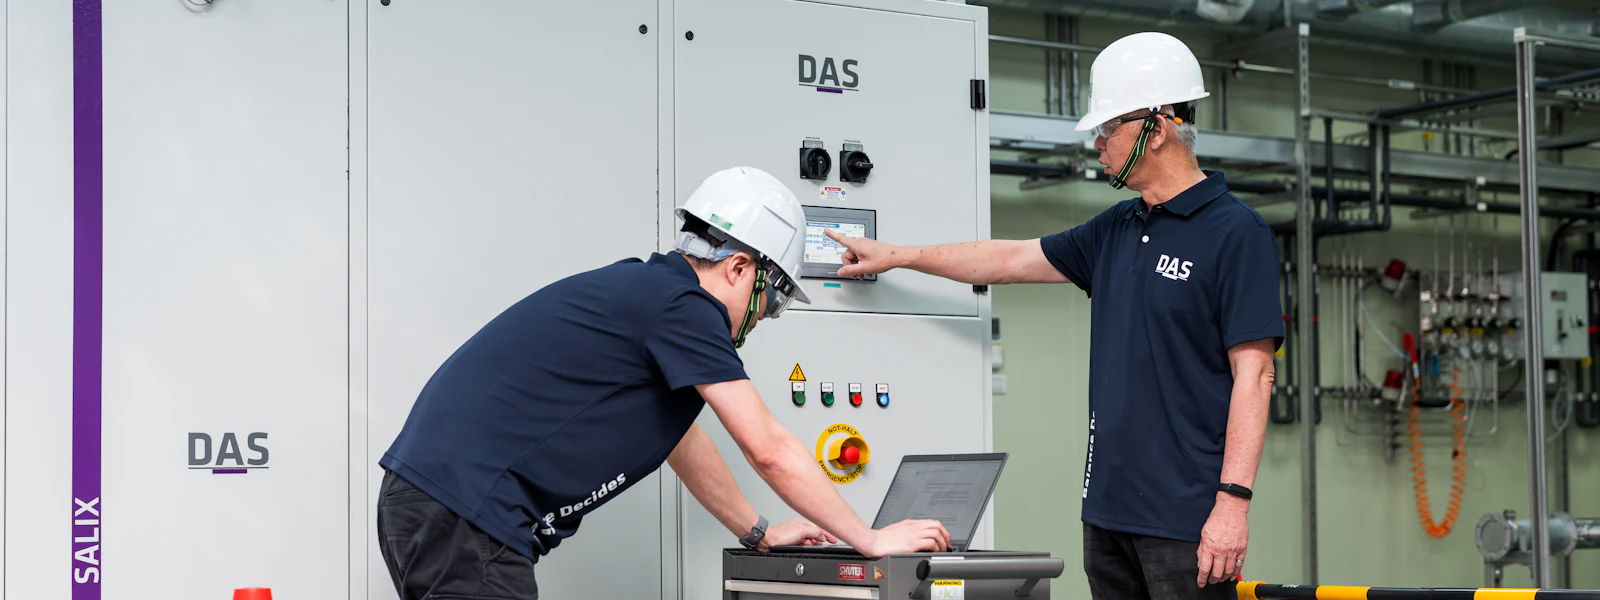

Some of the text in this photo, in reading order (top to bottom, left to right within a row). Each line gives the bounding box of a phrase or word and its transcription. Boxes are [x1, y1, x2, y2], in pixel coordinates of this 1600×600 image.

[799, 54, 859, 88] DAS
[1155, 254, 1193, 279] DAS
[827, 425, 858, 436] NOT-HALT
[188, 432, 269, 466] DAS
[559, 472, 626, 518] Decides
[74, 497, 100, 584] SALIX
[839, 566, 864, 577] SHUTER
